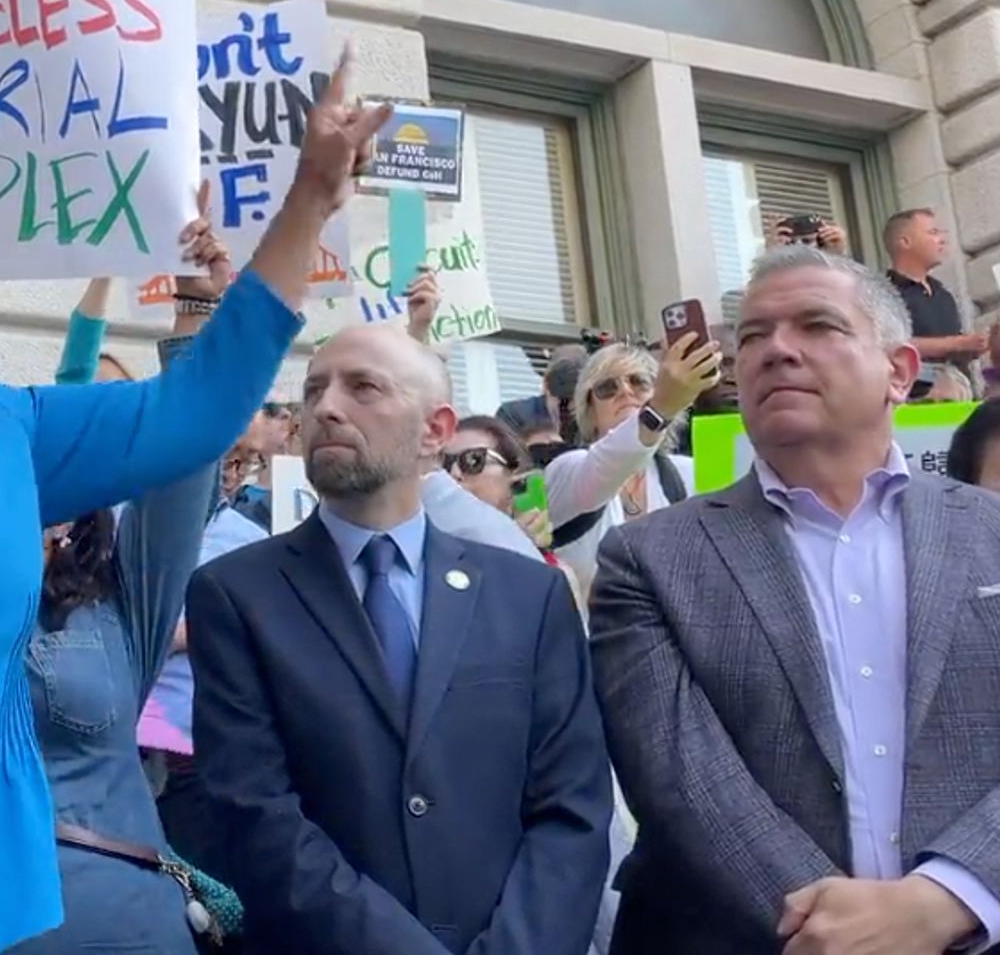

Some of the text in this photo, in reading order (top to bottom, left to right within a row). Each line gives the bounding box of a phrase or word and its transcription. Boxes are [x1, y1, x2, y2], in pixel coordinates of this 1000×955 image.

[396, 144, 426, 156] SAVE
[391, 153, 456, 170] FRANCISCO
[376, 165, 420, 179] DEFUND
